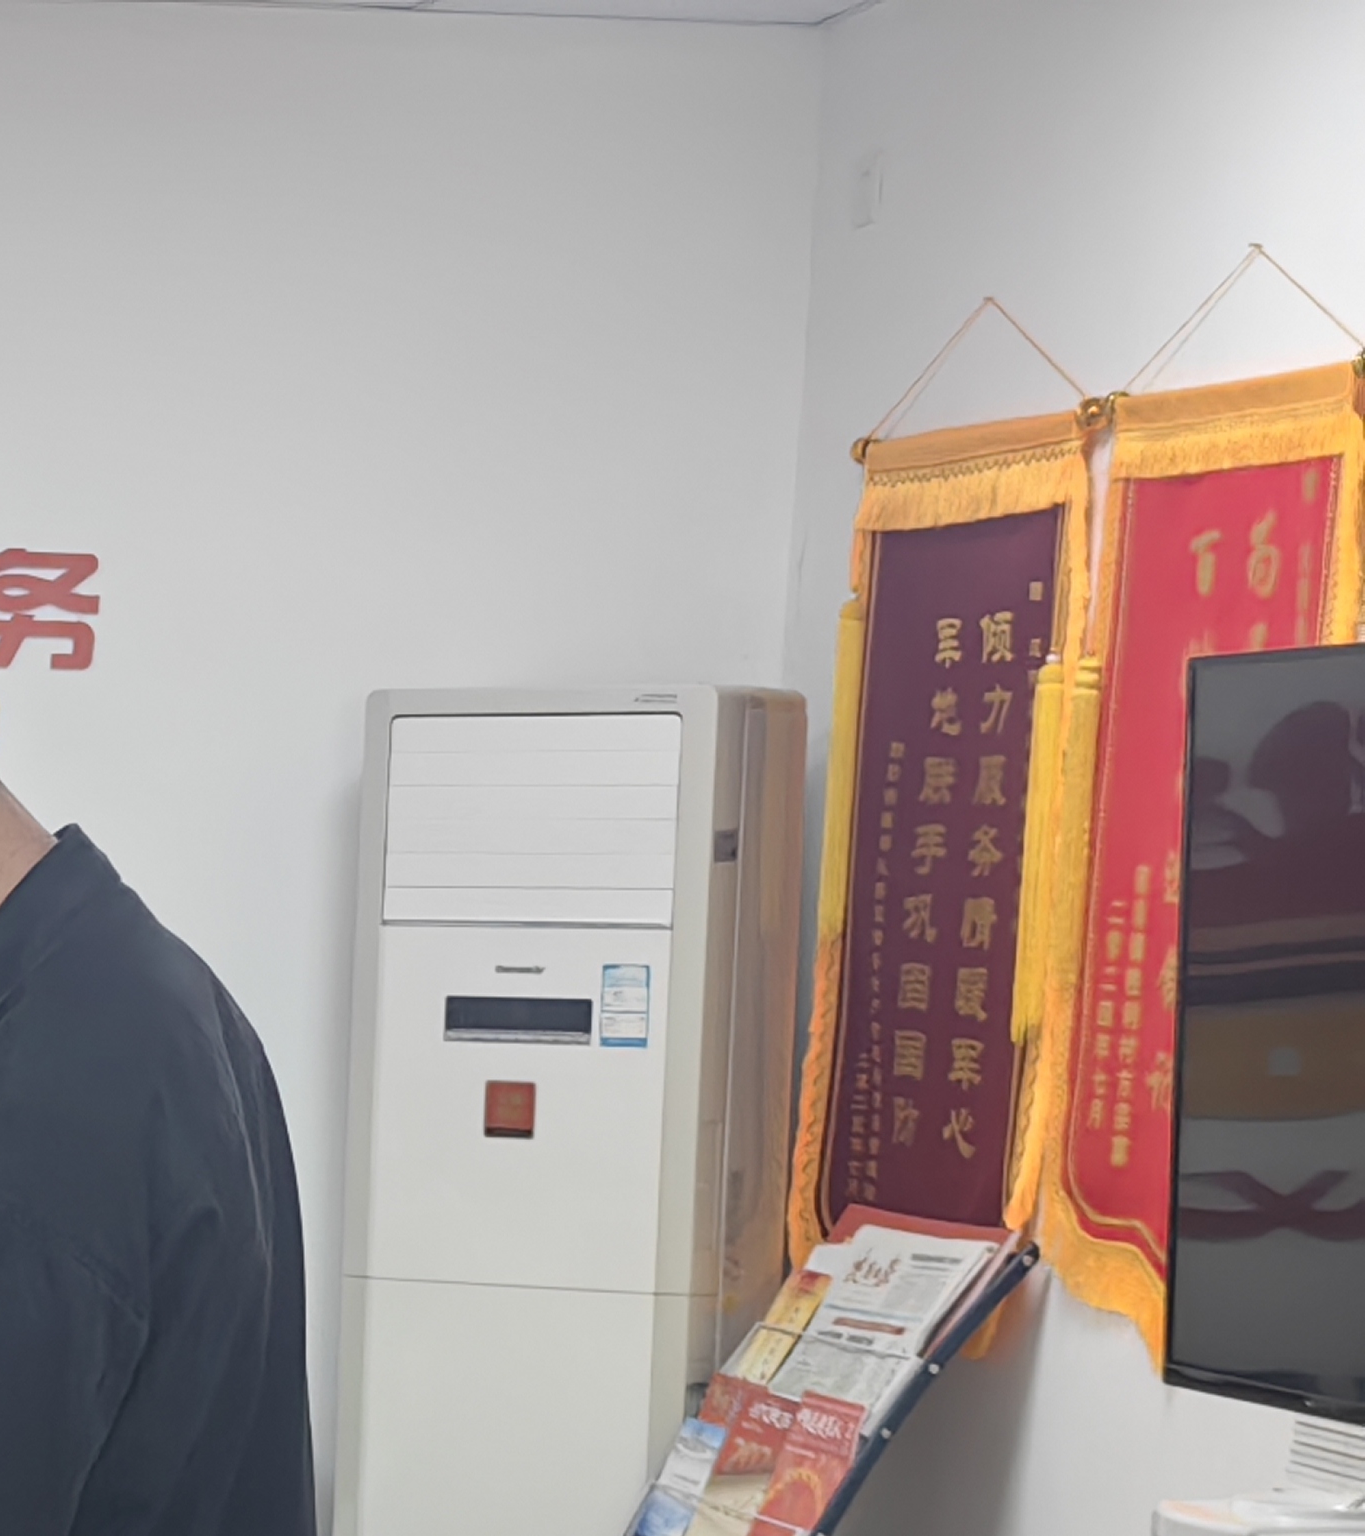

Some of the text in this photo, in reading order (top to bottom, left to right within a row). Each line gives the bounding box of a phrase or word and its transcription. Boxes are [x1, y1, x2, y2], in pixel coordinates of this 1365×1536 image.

[941, 611, 1016, 1159] 倾力服务情暖军心
